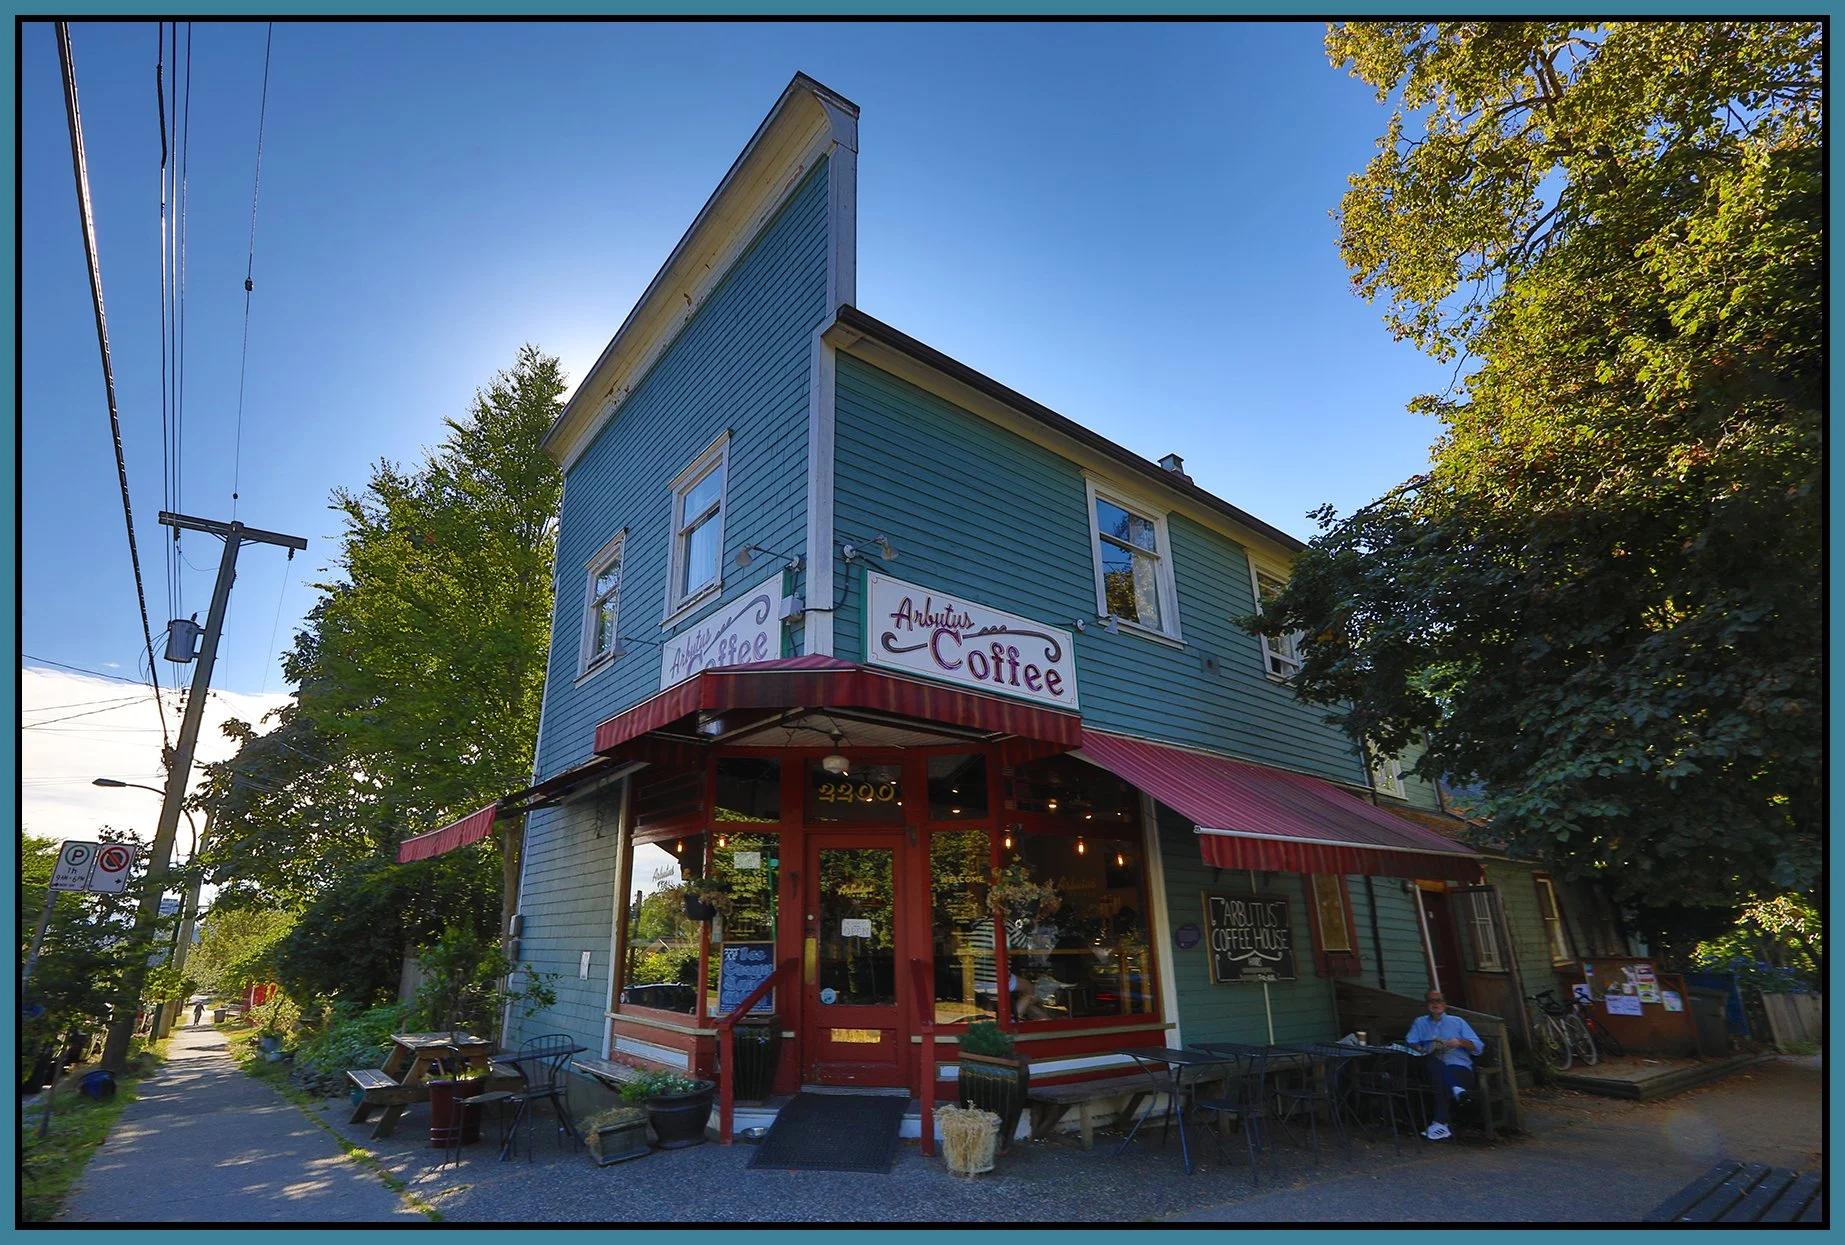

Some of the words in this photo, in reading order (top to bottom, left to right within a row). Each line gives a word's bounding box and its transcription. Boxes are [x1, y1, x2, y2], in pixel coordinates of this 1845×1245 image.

[889, 596, 975, 632] Arbutus
[669, 627, 712, 680] Arbutus
[928, 626, 1065, 697] Coffee
[818, 782, 896, 803] 2200
[71, 849, 84, 861] P
[940, 875, 985, 884] WELCOME
[1223, 900, 1278, 928] ARBUTUS
[1211, 927, 1254, 952] COFFEE
[1253, 927, 1290, 951] HOUSE
